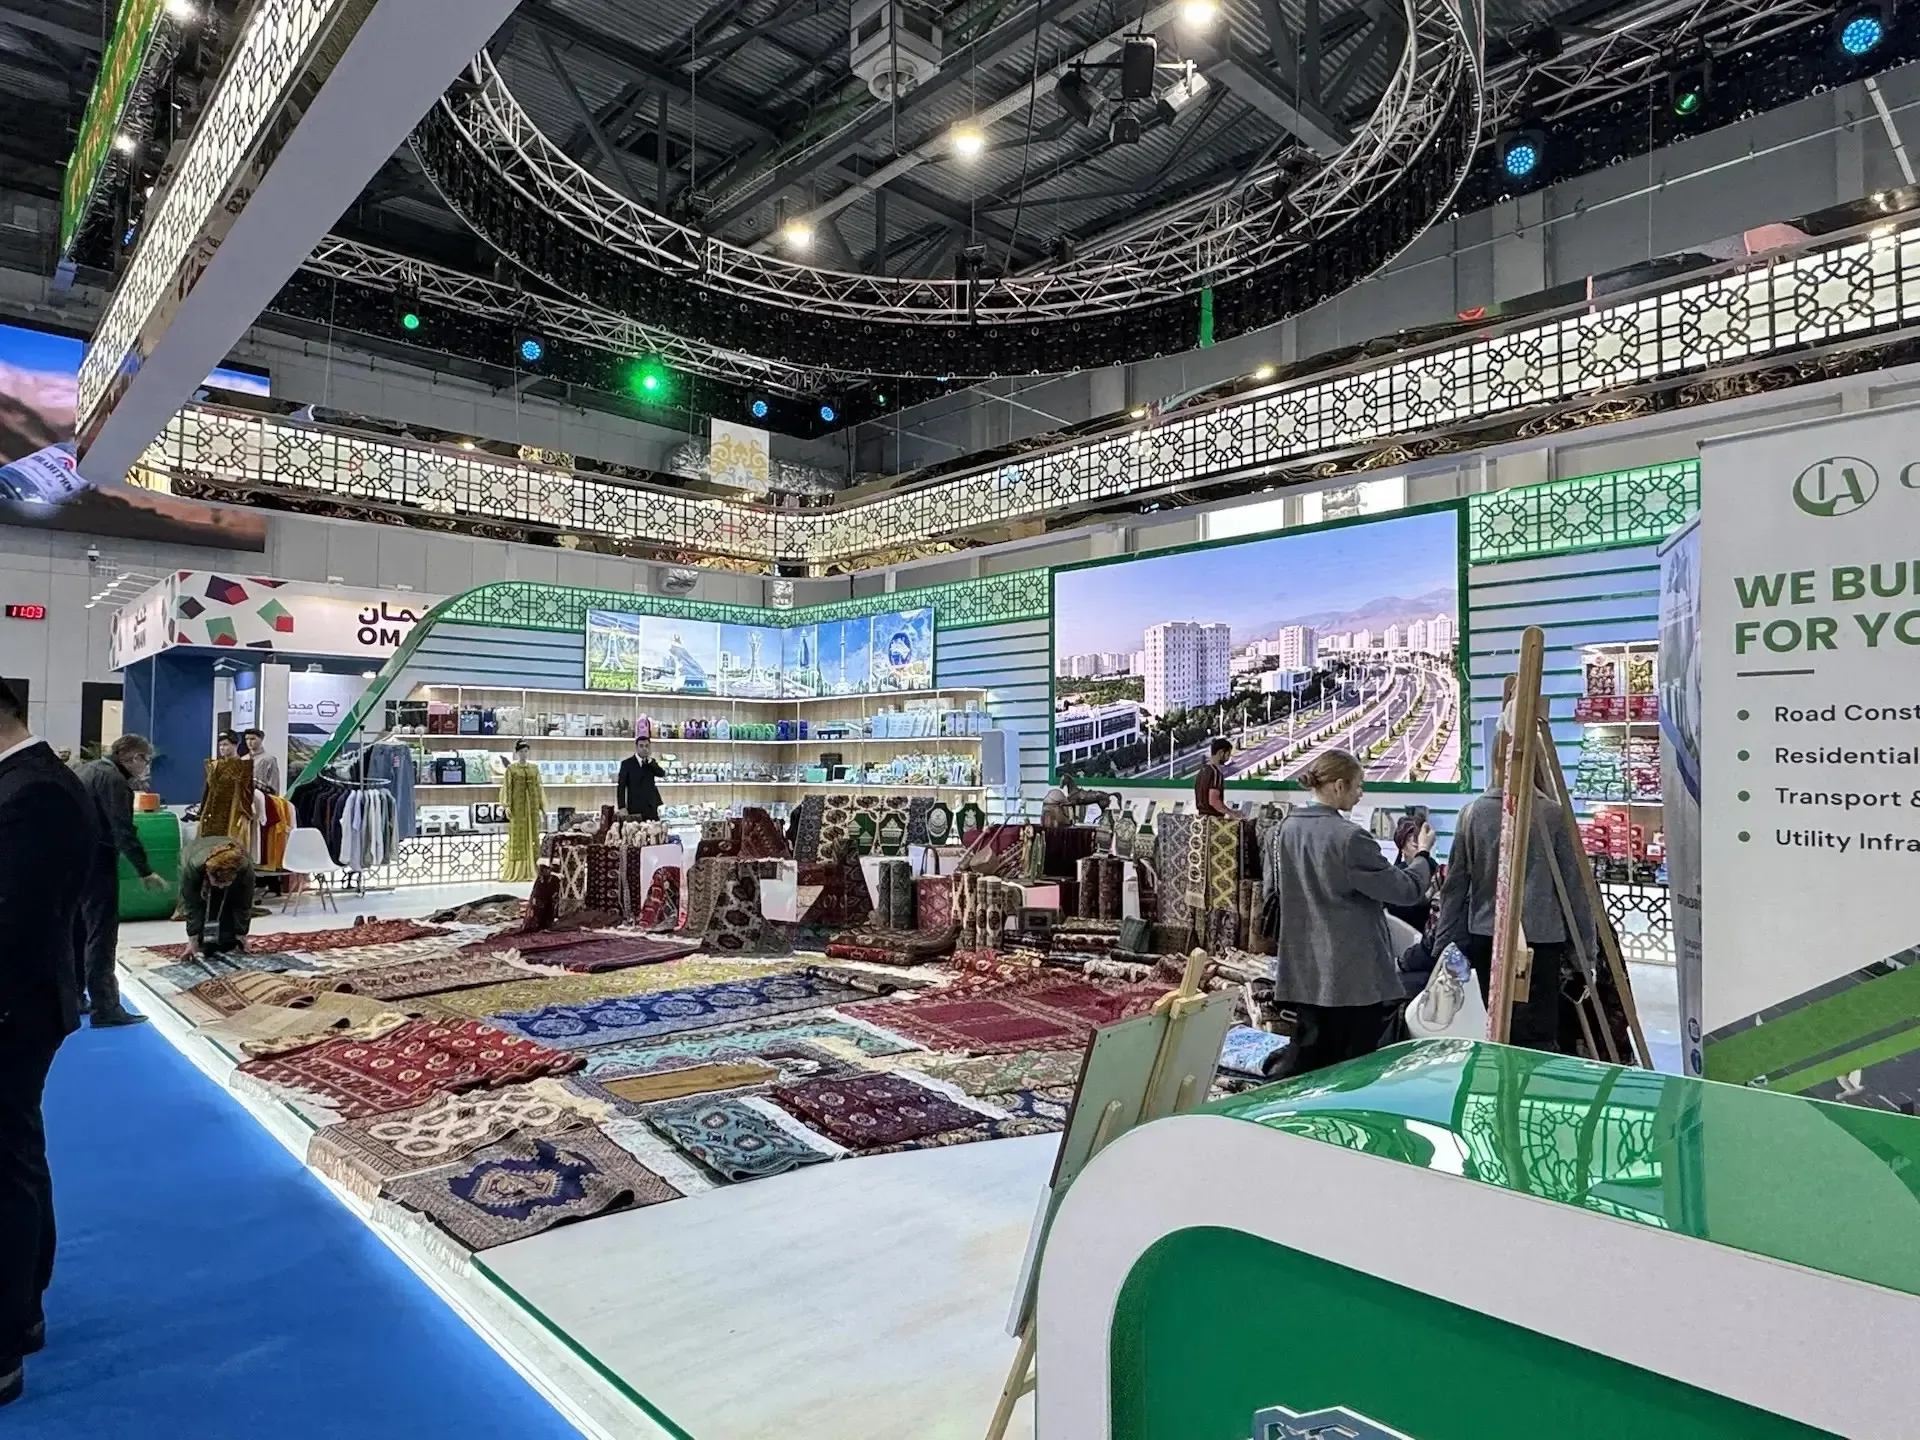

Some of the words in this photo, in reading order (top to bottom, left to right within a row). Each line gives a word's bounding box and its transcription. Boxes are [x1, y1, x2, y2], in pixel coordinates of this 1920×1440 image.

[1734, 570, 1816, 609] WE
[357, 626, 401, 647] OM
[1735, 616, 1838, 655] FOR
[1775, 704, 1836, 723] Road
[1775, 746, 1919, 765] Residential
[1775, 787, 1902, 811] Transport
[1776, 828, 1851, 853] Utility
[1859, 832, 1920, 853] Infra
